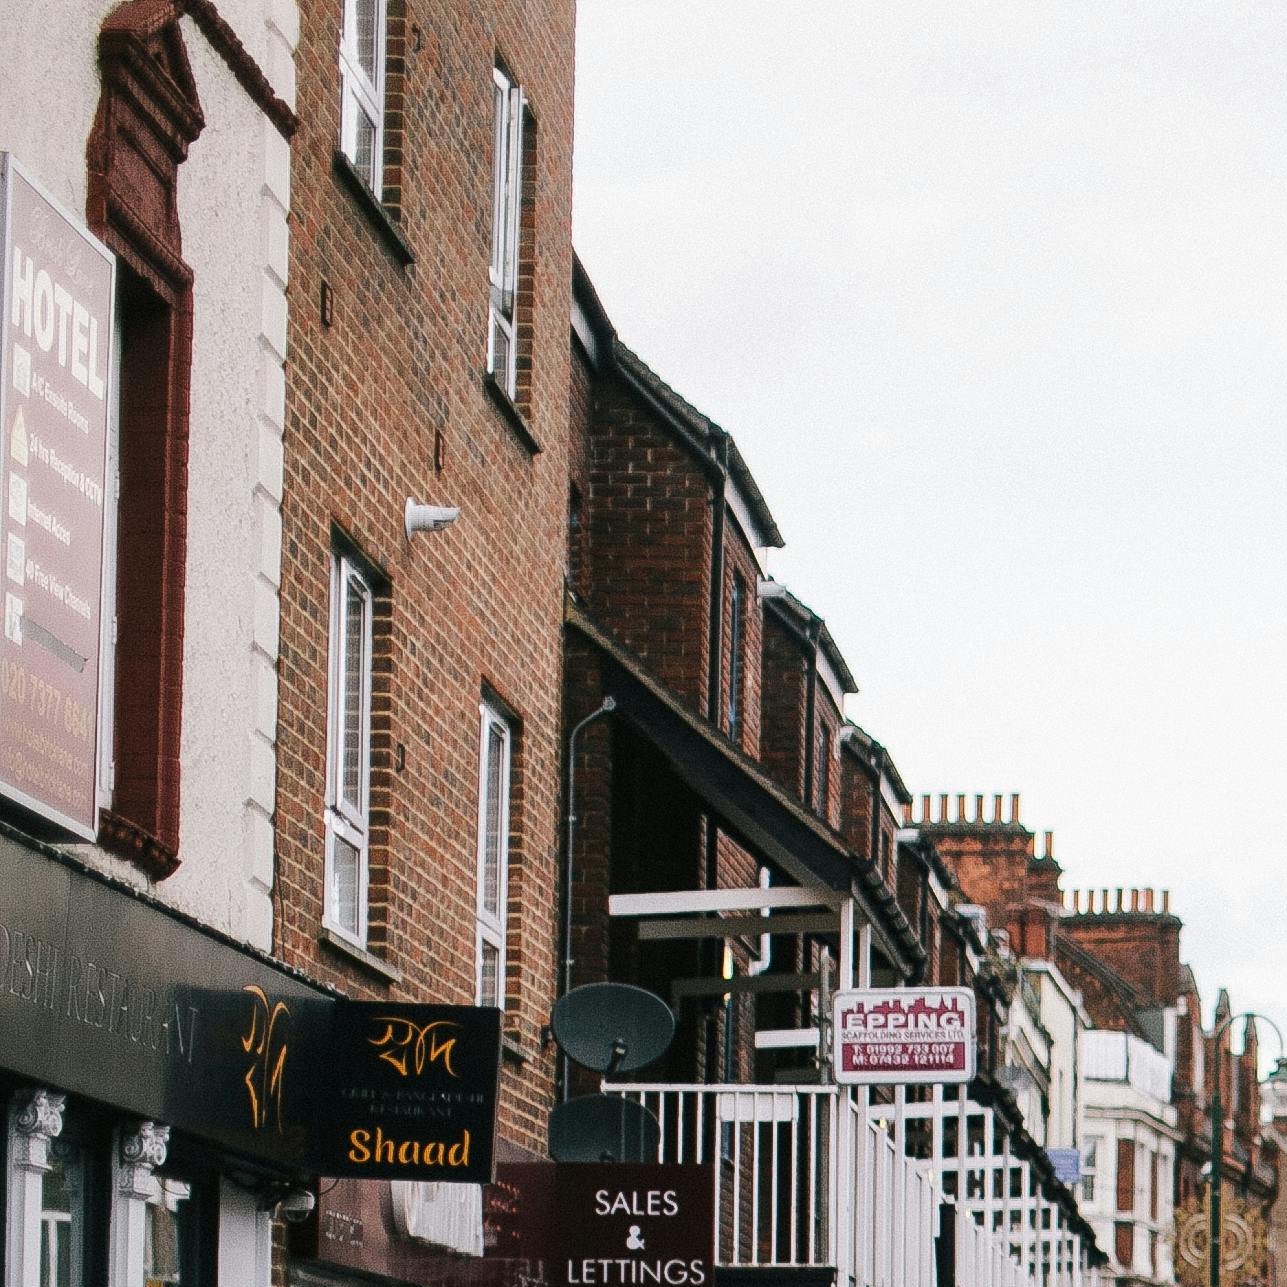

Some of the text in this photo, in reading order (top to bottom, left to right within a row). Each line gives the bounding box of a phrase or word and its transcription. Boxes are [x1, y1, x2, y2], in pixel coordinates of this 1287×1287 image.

[11, 240, 105, 402] HOTEL
[846, 1012, 960, 1030] EPPING
[842, 1031, 901, 1040] SCAFFOLDING
[904, 1031, 946, 1040] SERVICES
[349, 1126, 471, 1166] Shaad
[595, 1190, 678, 1216] SALES
[625, 1225, 645, 1251] &
[568, 1259, 706, 1286] LETTINGS
